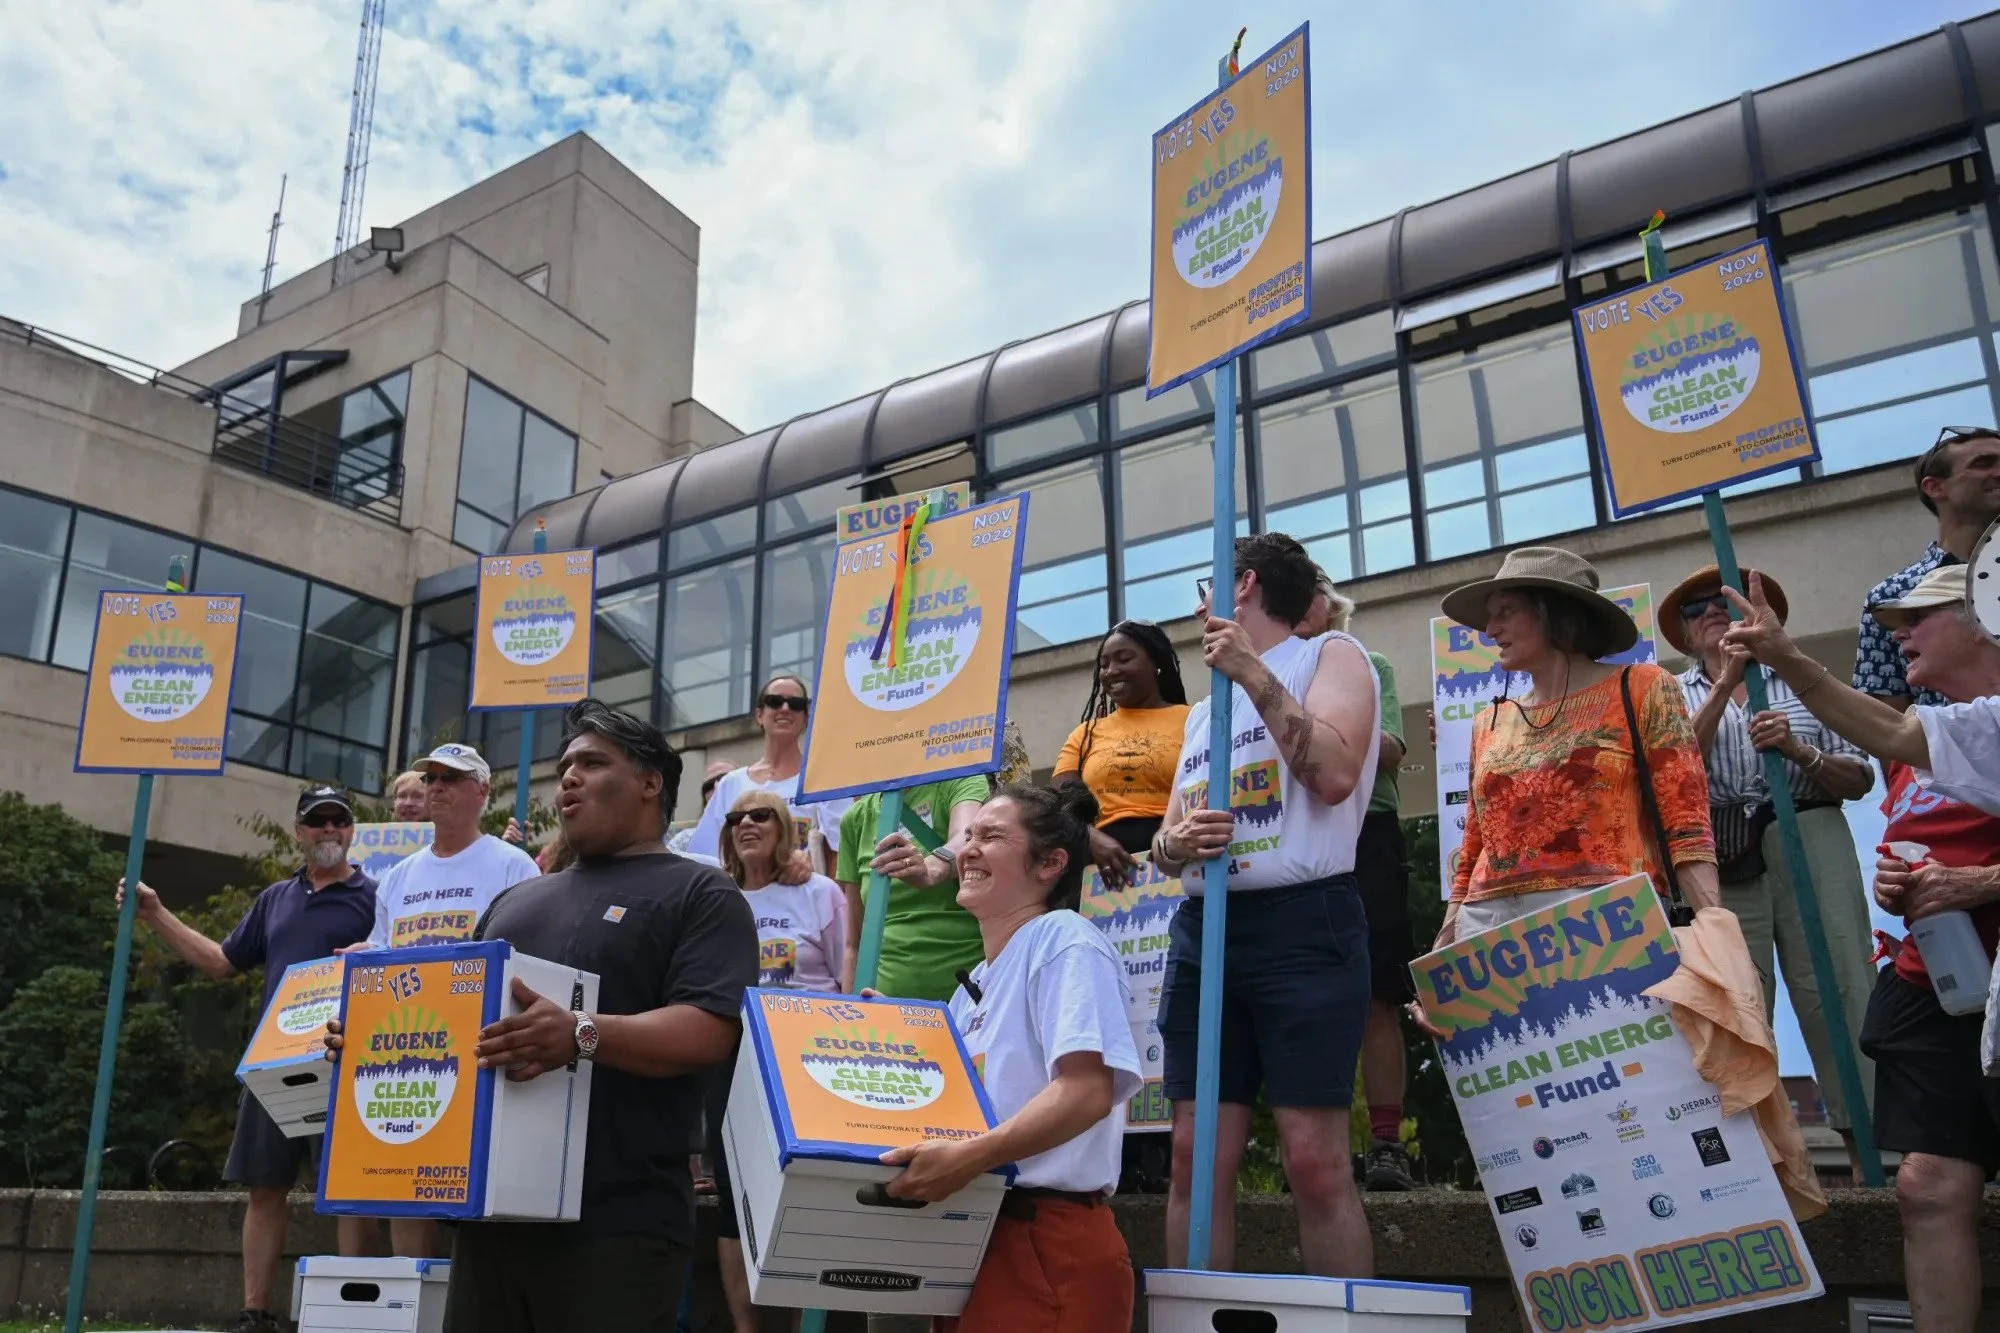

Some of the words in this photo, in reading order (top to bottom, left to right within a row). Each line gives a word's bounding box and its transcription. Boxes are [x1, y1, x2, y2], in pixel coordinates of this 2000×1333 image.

[1265, 43, 1298, 79] NOV
[1265, 65, 1299, 98] 2026
[1157, 117, 1193, 165] VOTE
[1197, 98, 1237, 144] YES
[1187, 139, 1268, 208] EUGENE
[1195, 196, 1262, 250] CLEAN
[1189, 212, 1268, 275] ENERGY
[1212, 249, 1242, 279] Fund
[1719, 253, 1758, 276] NOV
[1723, 268, 1764, 291] 2026
[1190, 318, 1207, 332] TURN
[1207, 297, 1246, 323] CORPORATE
[1249, 262, 1303, 302] PROFITS
[1244, 300, 1260, 313] INTO
[1261, 275, 1302, 308] COMMUNITY
[1248, 285, 1303, 324] POWER
[1584, 301, 1631, 333] VOTE
[1635, 286, 1684, 323] YES
[1634, 321, 1736, 368] EUGENE
[1653, 364, 1736, 402] CLEAN
[1648, 377, 1748, 421] ENERGY
[1680, 407, 1719, 425] Fund
[1661, 457, 1683, 467] TURN
[1684, 440, 1733, 461] CORPORATE
[1736, 418, 1804, 445] PROFITS
[1733, 443, 1753, 454] INTO
[1754, 427, 1805, 449] COMMUNITY
[1739, 435, 1806, 463] POWER
[847, 492, 959, 534] EUGEE
[973, 507, 1013, 531] NOV
[971, 528, 1012, 548] 2026
[567, 555, 589, 565] NOV
[840, 543, 885, 576] VOTE
[484, 560, 512, 576] VOTE
[516, 560, 543, 580] YES
[105, 596, 140, 616] VOTE
[145, 601, 177, 624] YES
[208, 601, 236, 611] NOV
[505, 596, 566, 612] EUGENE
[207, 614, 236, 623] 2026
[510, 627, 560, 639] CLEAN
[128, 645, 203, 659] EUGENE
[504, 638, 564, 651] ENERGY
[871, 637, 953, 671] CEAN
[521, 651, 544, 659] Fund
[860, 655, 960, 693] ENERGY
[132, 679, 194, 691] CLEAN
[886, 682, 924, 702] Fund
[124, 692, 197, 705] ENERGY
[144, 707, 172, 715] Fund
[1442, 701, 1489, 721] CLE
[855, 738, 876, 749] TURN
[876, 730, 924, 745] CORPORATE
[928, 712, 995, 737] PROFITS
[921, 736, 941, 747] INTO
[941, 727, 993, 744] COMMUNITY
[925, 736, 993, 760] POWER
[403, 890, 433, 905] SIGN
[435, 887, 474, 900] HERE
[396, 914, 469, 935] EUGENE
[1428, 896, 1644, 1004] EUGENE
[452, 960, 483, 976] NOV
[350, 966, 385, 995] VOTE
[387, 966, 422, 1003] YES
[450, 980, 483, 994] 2026
[763, 995, 814, 1015] VOTE
[819, 1003, 866, 1023] YES
[900, 1006, 936, 1018] NOV
[905, 1018, 943, 1028] 2026
[370, 1030, 447, 1051] EUGENE
[814, 1037, 919, 1056] EUGENE
[1456, 1050, 1552, 1099] CLEAN
[1556, 1011, 1675, 1068] ENERG
[835, 1068, 923, 1085] CLEAN
[1534, 1060, 1621, 1110] Fund
[373, 1081, 437, 1099] CLEAN
[831, 1078, 933, 1097] ENERGY
[366, 1100, 441, 1119] ENERGY
[865, 1094, 905, 1105] Fund
[1680, 1098, 1710, 1111] SIERRA
[385, 1120, 414, 1133] Fund
[870, 1123, 921, 1133] CORPORATE
[1555, 1130, 1588, 1146] Breach
[1700, 1139, 1721, 1151] PSR
[1491, 1148, 1519, 1160] BEYOND
[1494, 1155, 1521, 1166] TOXICS
[1634, 1155, 1656, 1167] 350
[417, 1166, 467, 1178] PROFITS
[1632, 1164, 1664, 1181] EUGENE
[415, 1187, 465, 1200] POWER
[829, 1273, 885, 1286] BANKERS
[887, 1276, 915, 1287] BOX
[1529, 1260, 1643, 1332] SIGN
[1640, 1225, 1803, 1311] HERE!
